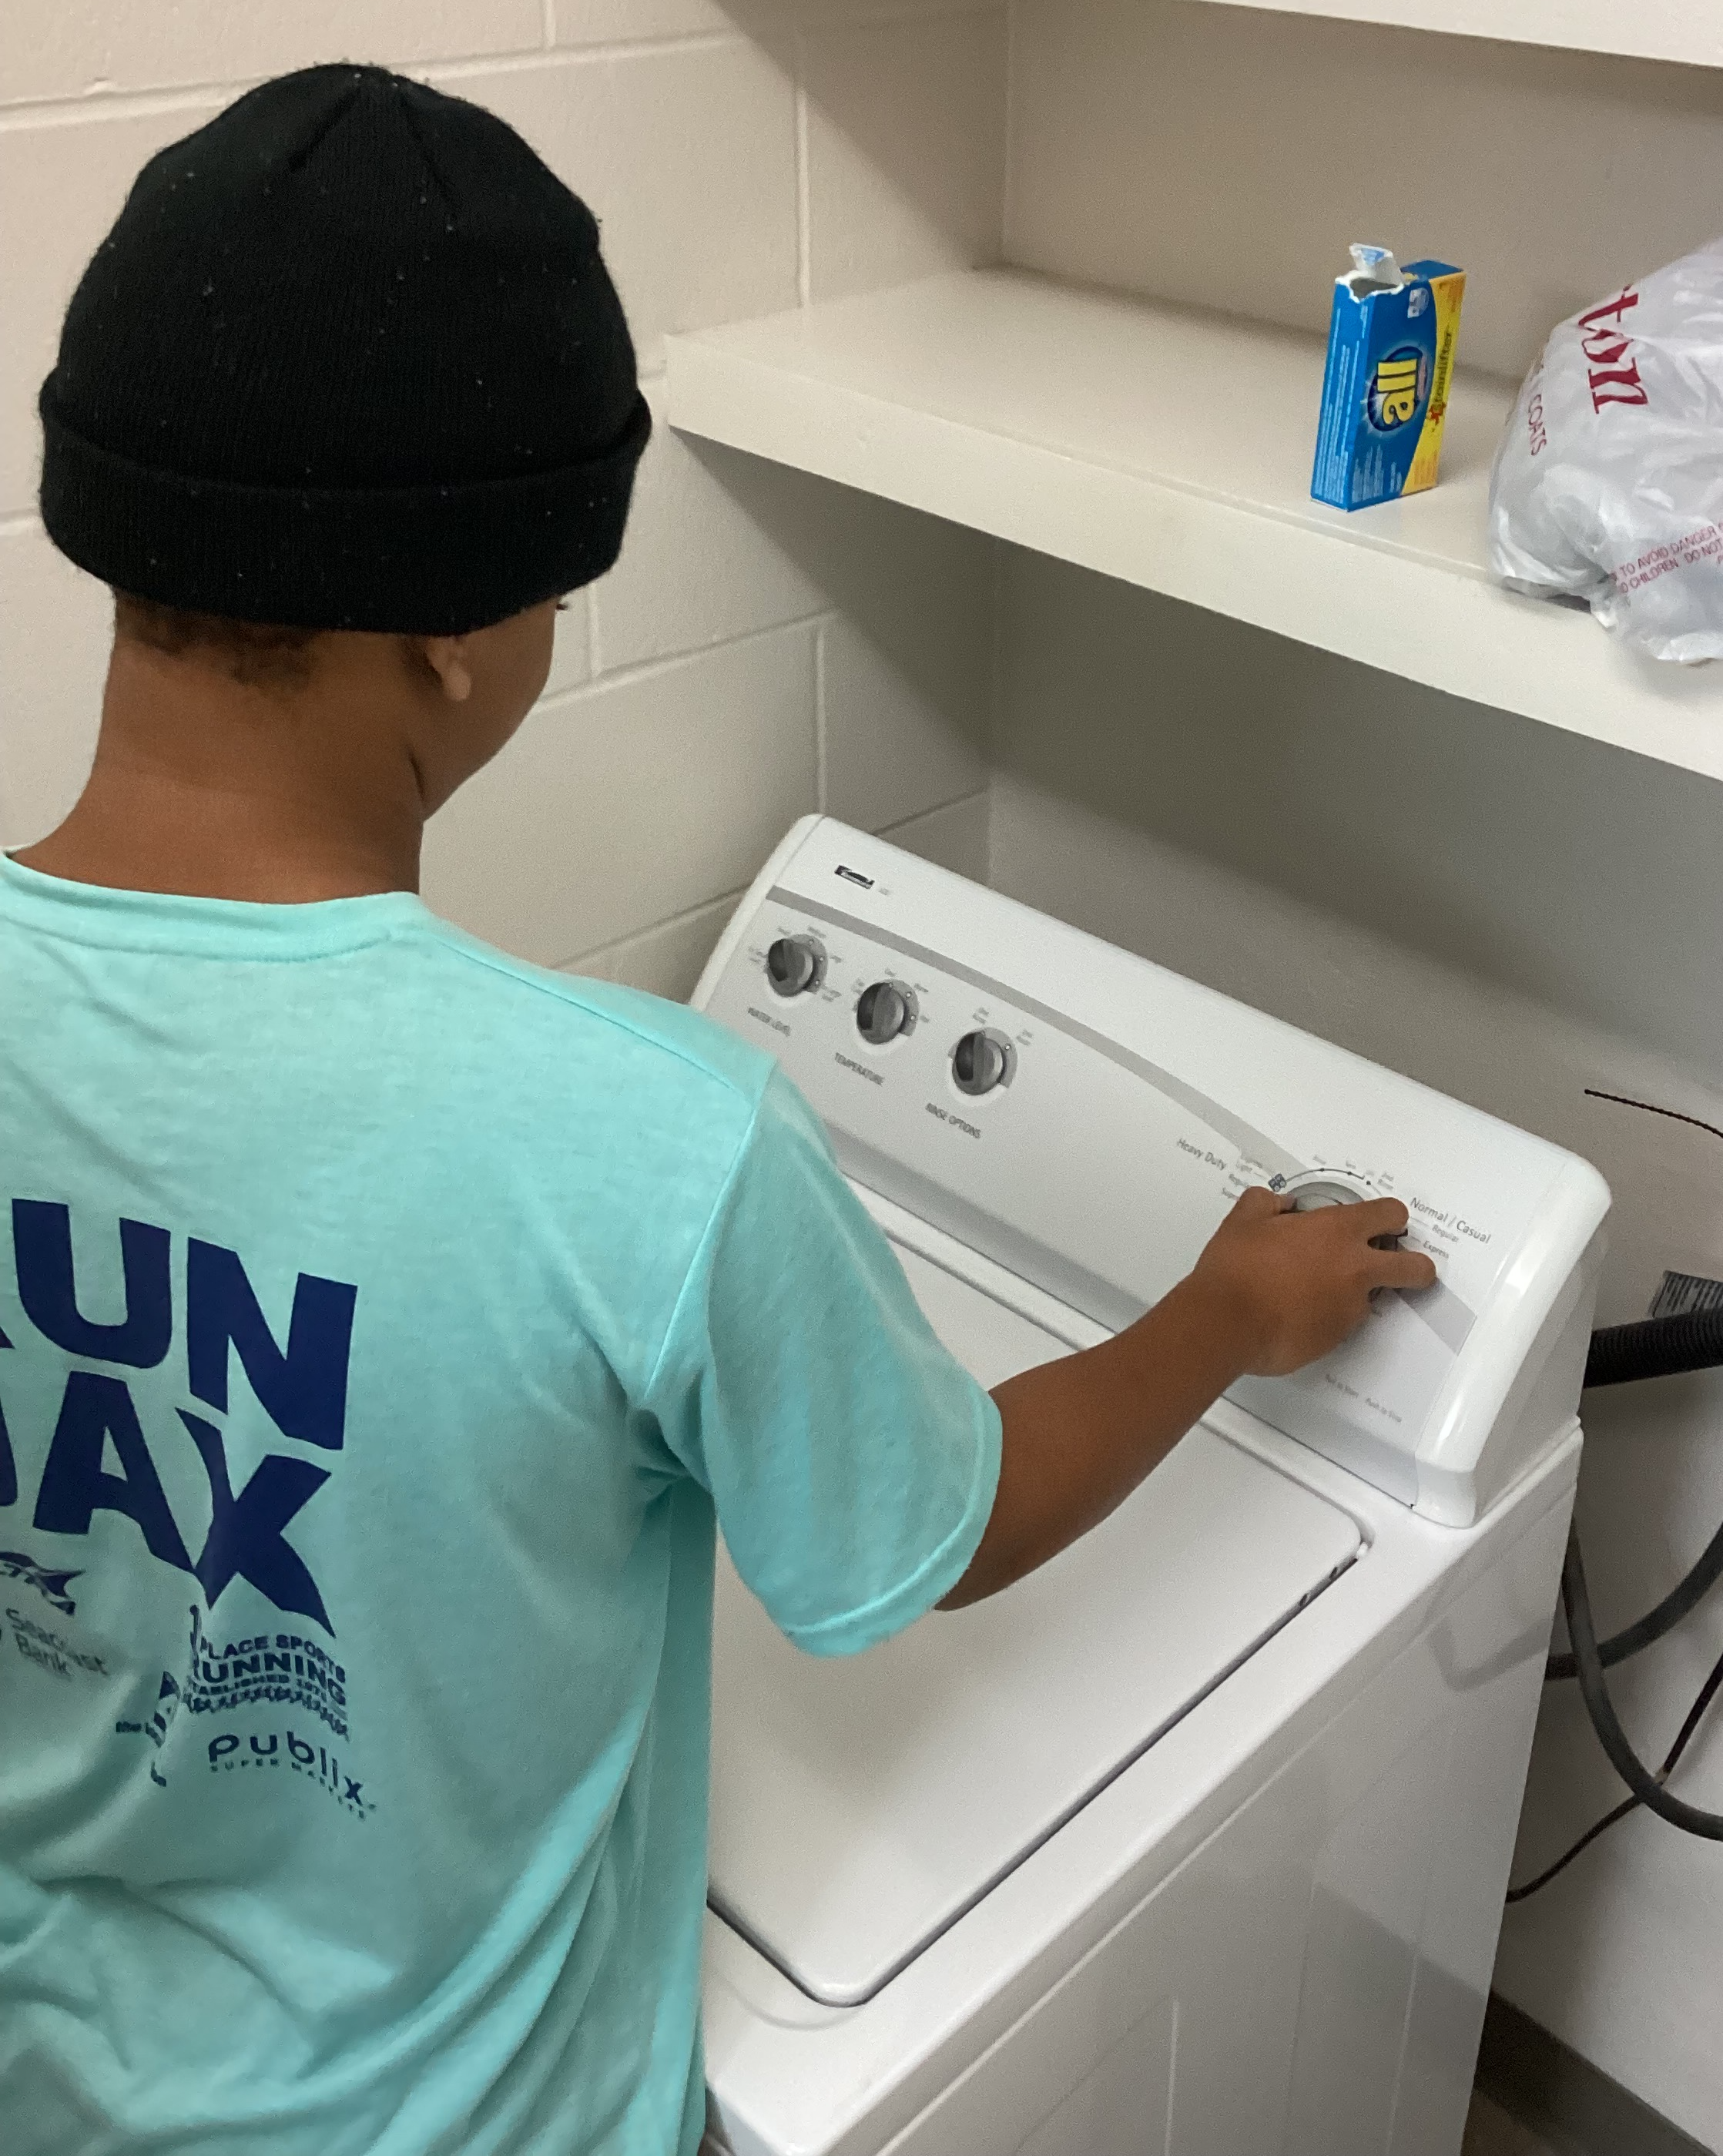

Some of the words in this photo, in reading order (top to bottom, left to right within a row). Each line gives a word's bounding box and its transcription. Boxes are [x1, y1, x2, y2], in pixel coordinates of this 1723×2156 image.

[1376, 359, 1417, 426] all
[1528, 394, 1547, 456] COATS
[1619, 562, 1635, 577] TO
[1638, 547, 1668, 569] AVOID
[1670, 525, 1717, 554] DANGER
[1630, 558, 1678, 588] CHILDREN
[1684, 550, 1700, 563] DO
[1701, 538, 1722, 555] NOT
[949, 1112, 981, 1138] OPTIONS
[1205, 1151, 1226, 1171] Duty
[1410, 1197, 1448, 1222] Normal
[1457, 1220, 1492, 1244] Casual
[1423, 1240, 1450, 1259] Express
[0, 1199, 358, 1450] UN
[275, 1634, 346, 1684] SPORTS
